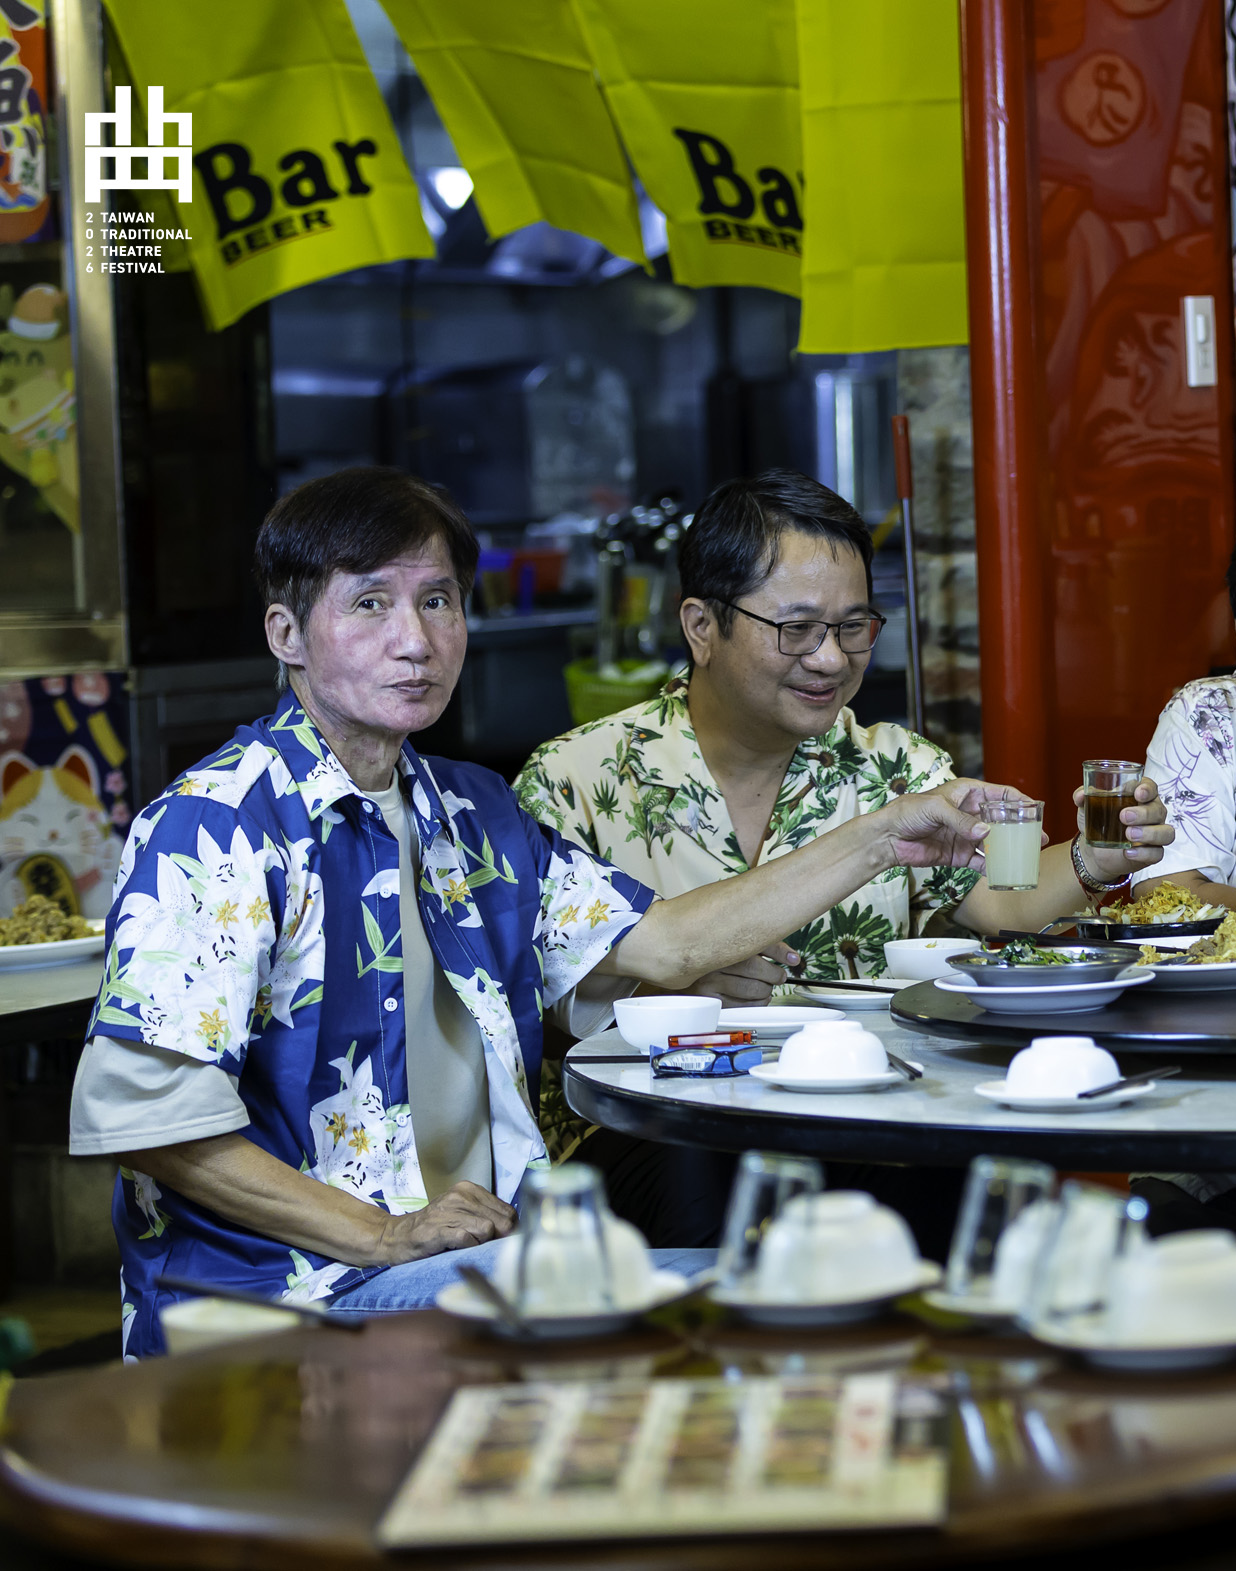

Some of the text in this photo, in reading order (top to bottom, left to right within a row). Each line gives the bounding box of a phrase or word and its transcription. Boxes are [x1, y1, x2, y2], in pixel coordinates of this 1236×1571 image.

[193, 138, 378, 242] Bar
[672, 127, 804, 231] Ba
[220, 209, 332, 266] BEER
[704, 219, 802, 256] BEER
